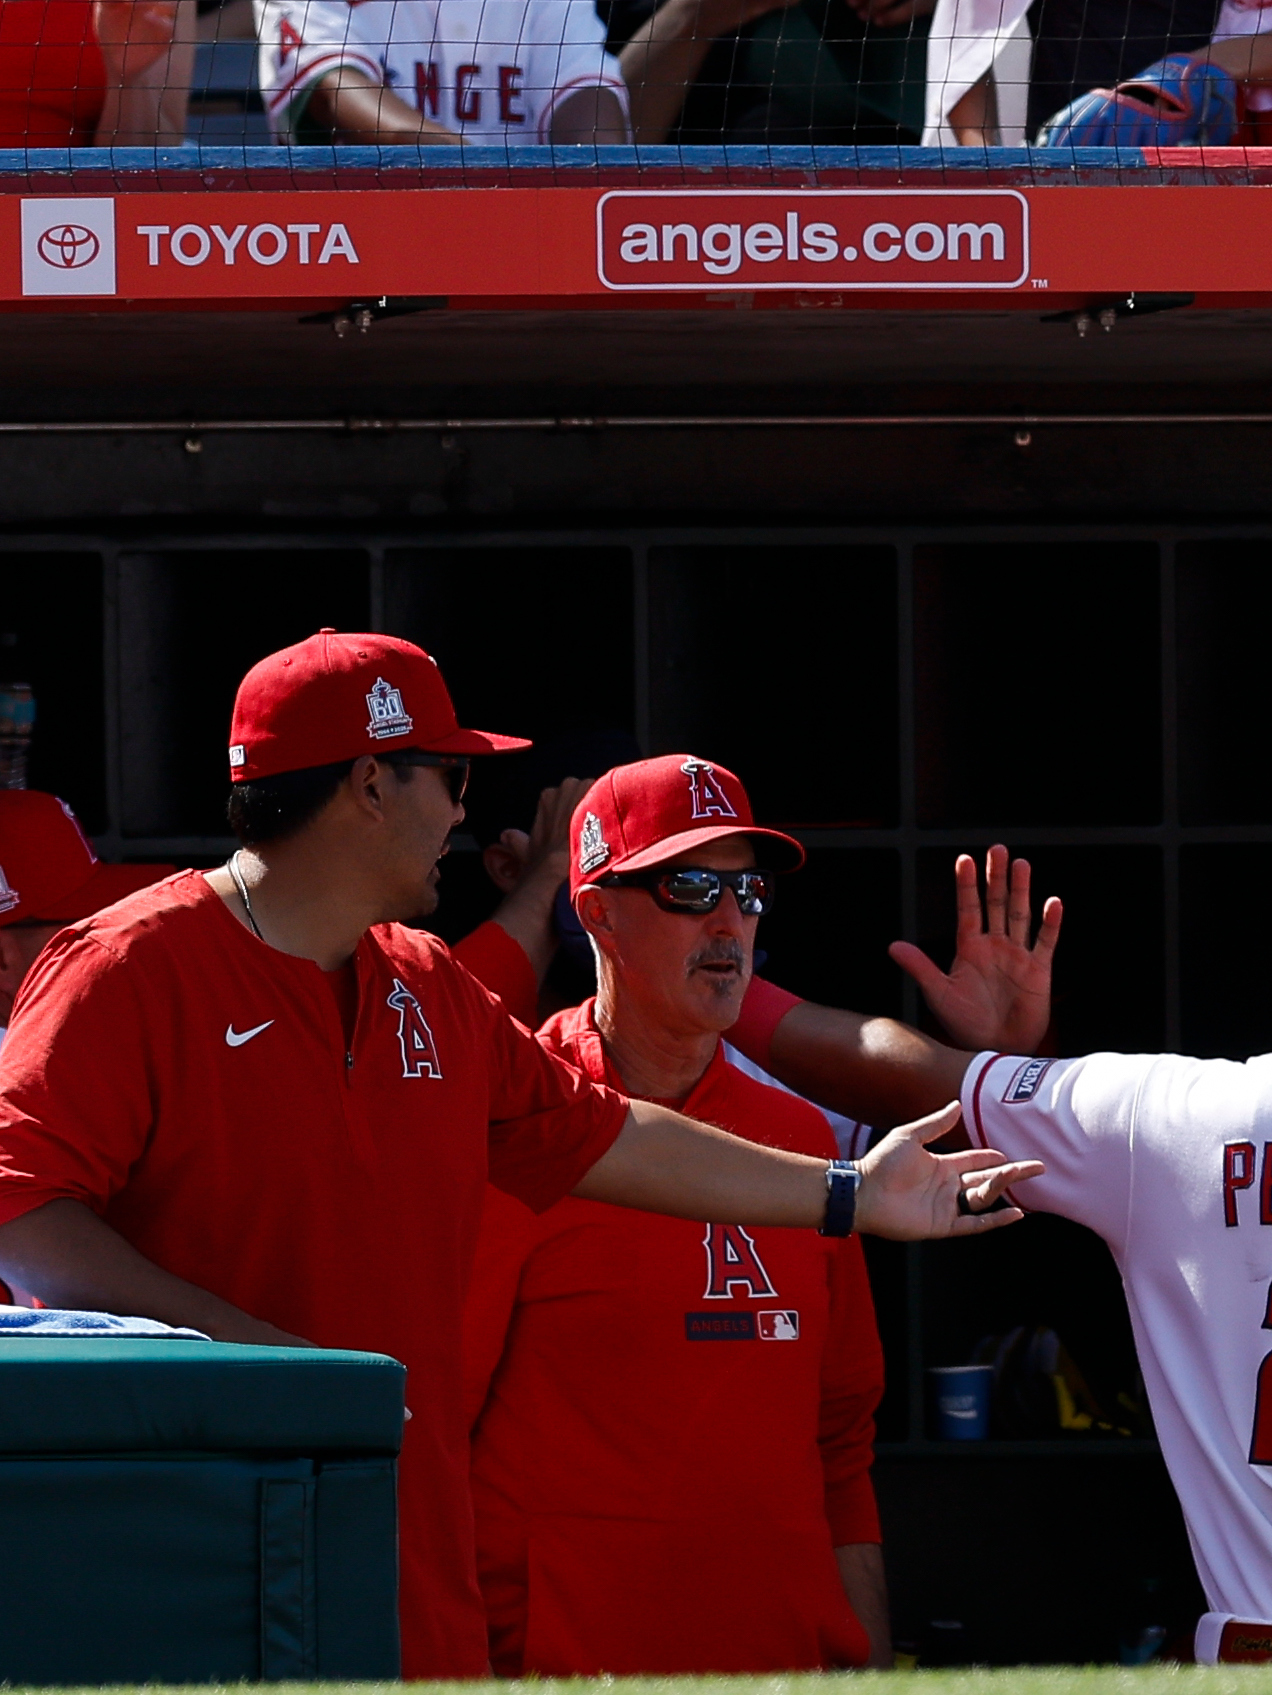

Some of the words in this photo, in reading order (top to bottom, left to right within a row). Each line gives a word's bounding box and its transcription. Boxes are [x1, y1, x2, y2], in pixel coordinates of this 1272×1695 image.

[137, 223, 359, 266] TOYOTA
[620, 211, 1005, 275] angels.com
[373, 697, 400, 719] 60
[681, 757, 738, 819] A
[390, 982, 444, 1080] A
[703, 1222, 779, 1299] A
[690, 1319, 749, 1333] ANGELS
